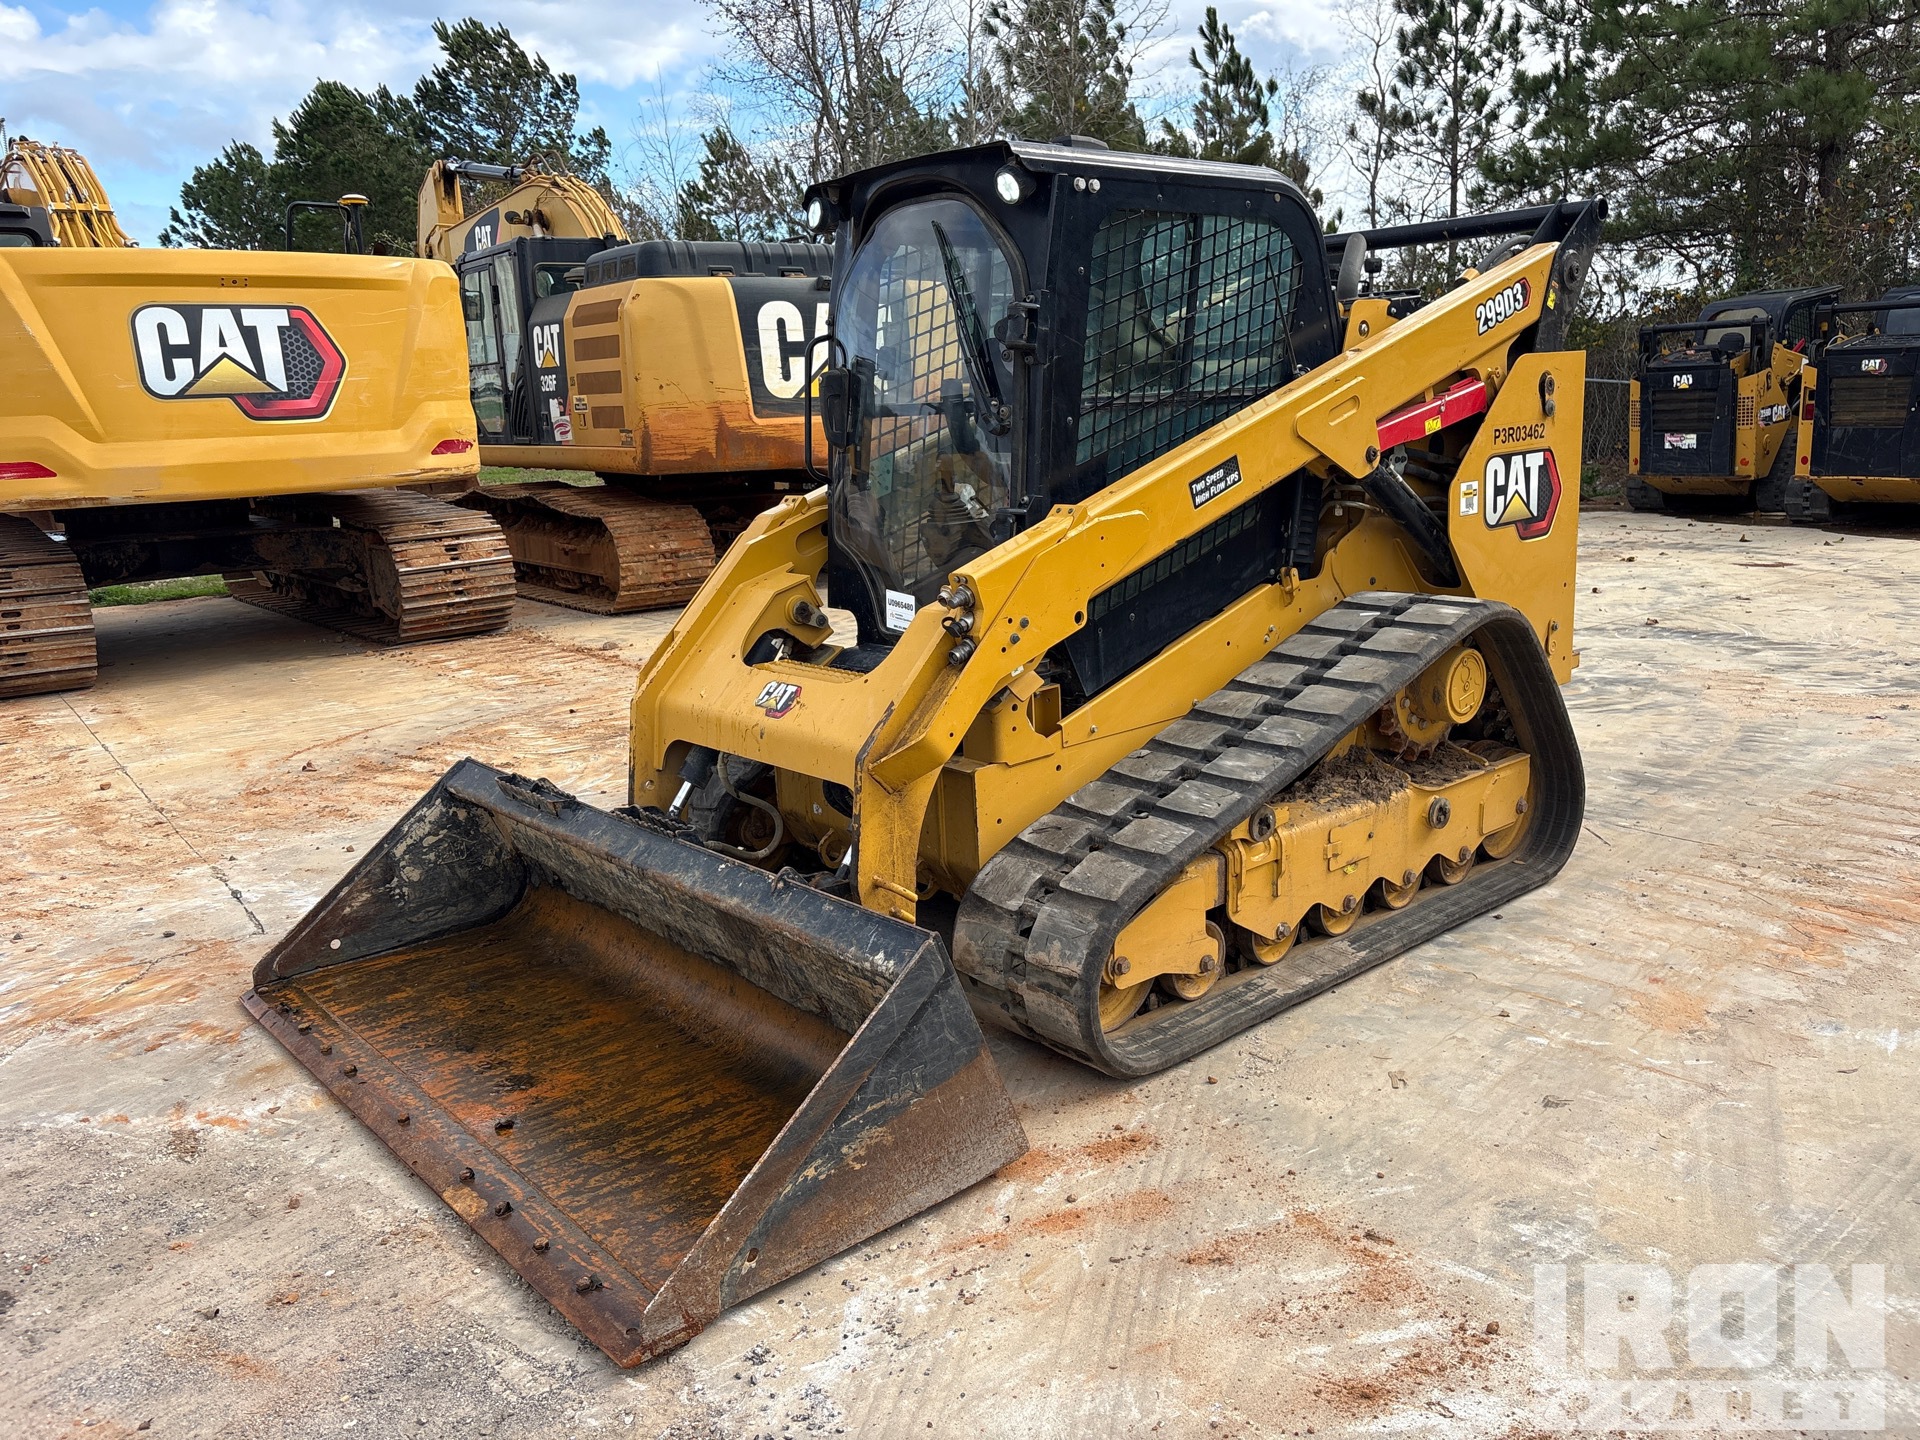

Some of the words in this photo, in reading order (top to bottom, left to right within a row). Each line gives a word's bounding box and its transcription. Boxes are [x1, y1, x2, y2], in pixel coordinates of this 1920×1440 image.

[475, 225, 491, 251] CAT
[1476, 282, 1523, 335] 299D3
[134, 306, 291, 396] CAT
[533, 323, 560, 368] CAT
[1861, 359, 1881, 371] CAT
[540, 374, 557, 392] 326F
[1672, 373, 1693, 388] CAT
[1772, 403, 1786, 422] CAT
[1493, 422, 1546, 446] P3R03462
[1191, 480, 1206, 495] TWO
[1205, 468, 1224, 486] SPEED
[1210, 480, 1226, 497] FLOW
[1226, 471, 1239, 487] XPS
[1485, 451, 1544, 526] CAT
[756, 680, 798, 710] CAT
